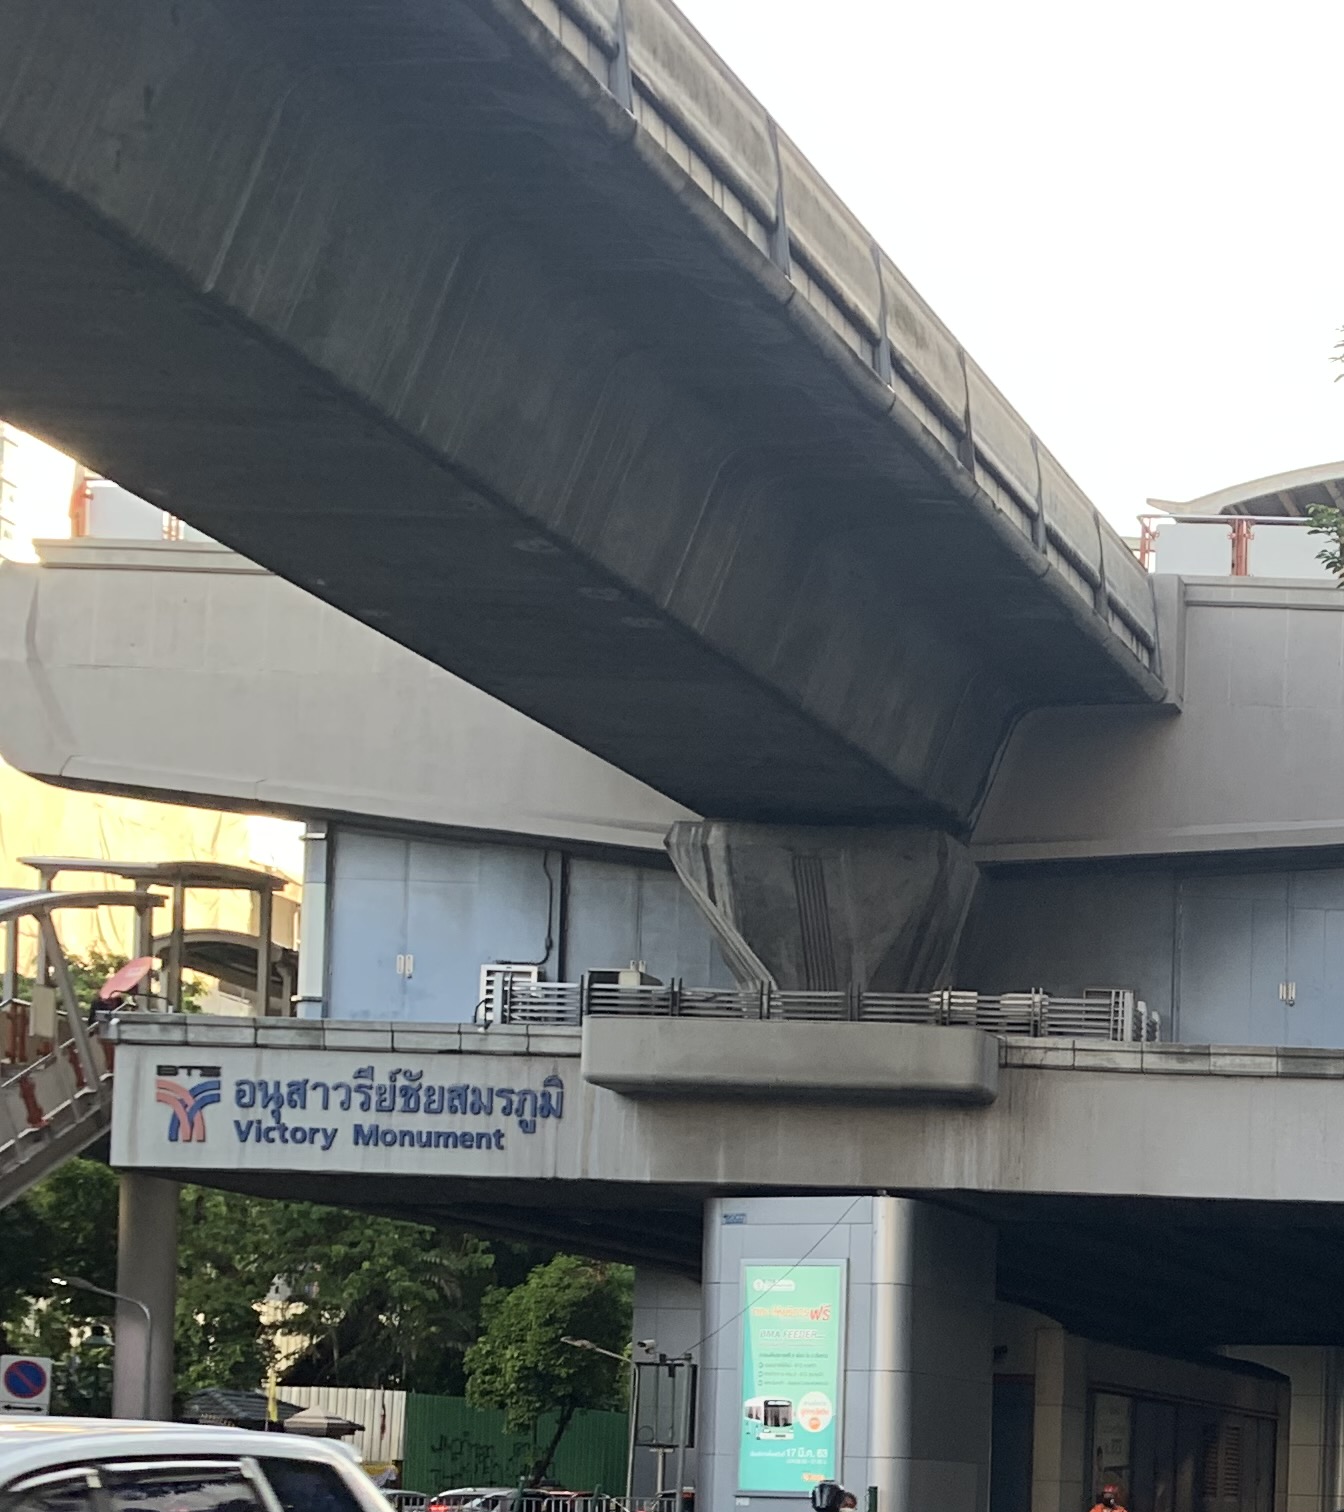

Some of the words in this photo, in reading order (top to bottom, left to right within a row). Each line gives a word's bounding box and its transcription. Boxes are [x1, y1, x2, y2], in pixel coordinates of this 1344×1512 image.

[156, 1064, 222, 1078] BTS
[234, 1065, 565, 1134] อนุสาวรีย์ชัยสมรภูมิ
[234, 1119, 338, 1151] Victory
[353, 1122, 505, 1151] Monument
